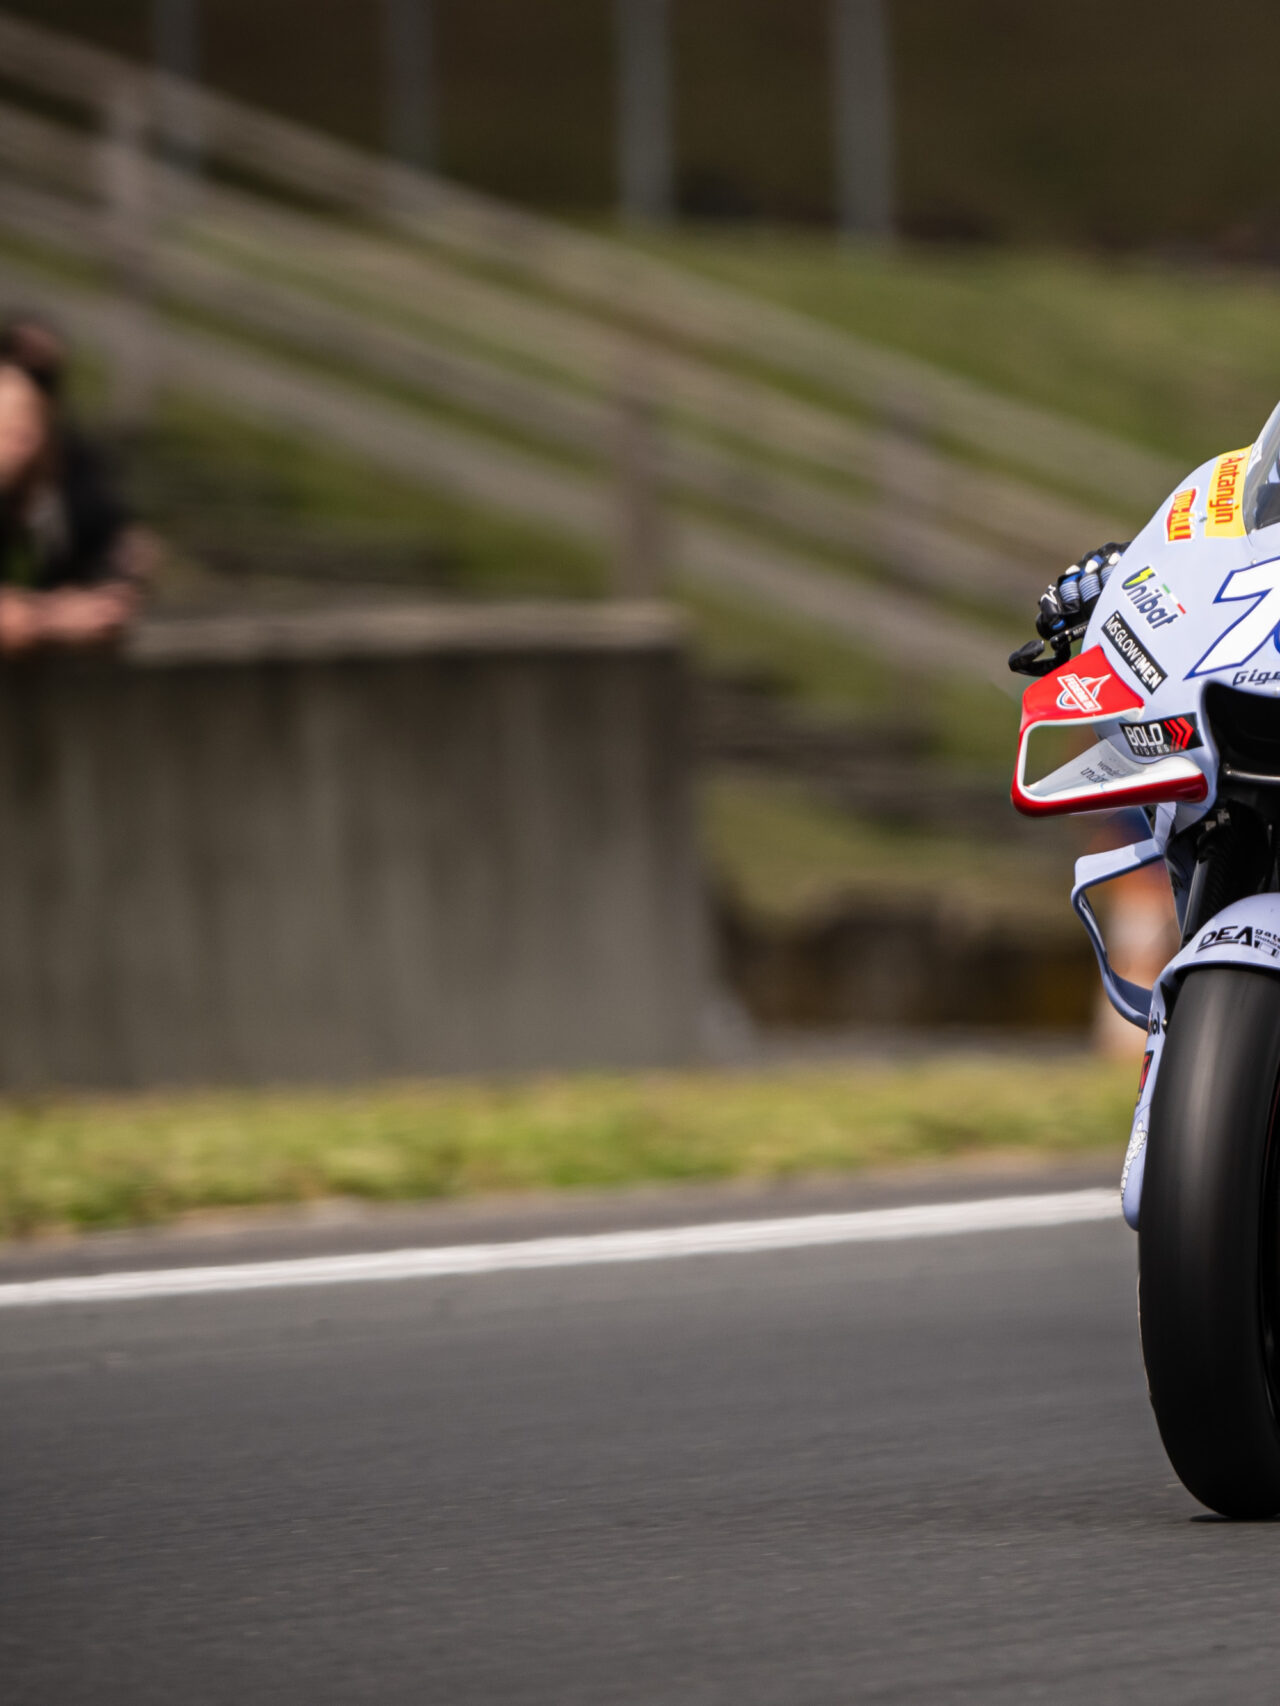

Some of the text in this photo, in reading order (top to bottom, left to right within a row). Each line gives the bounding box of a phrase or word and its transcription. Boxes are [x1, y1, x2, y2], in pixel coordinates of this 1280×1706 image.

[1208, 456, 1245, 525] Antangin
[1121, 565, 1179, 630] Unibat
[1124, 722, 1165, 747] BOLD
[1133, 744, 1171, 757] RIDERS
